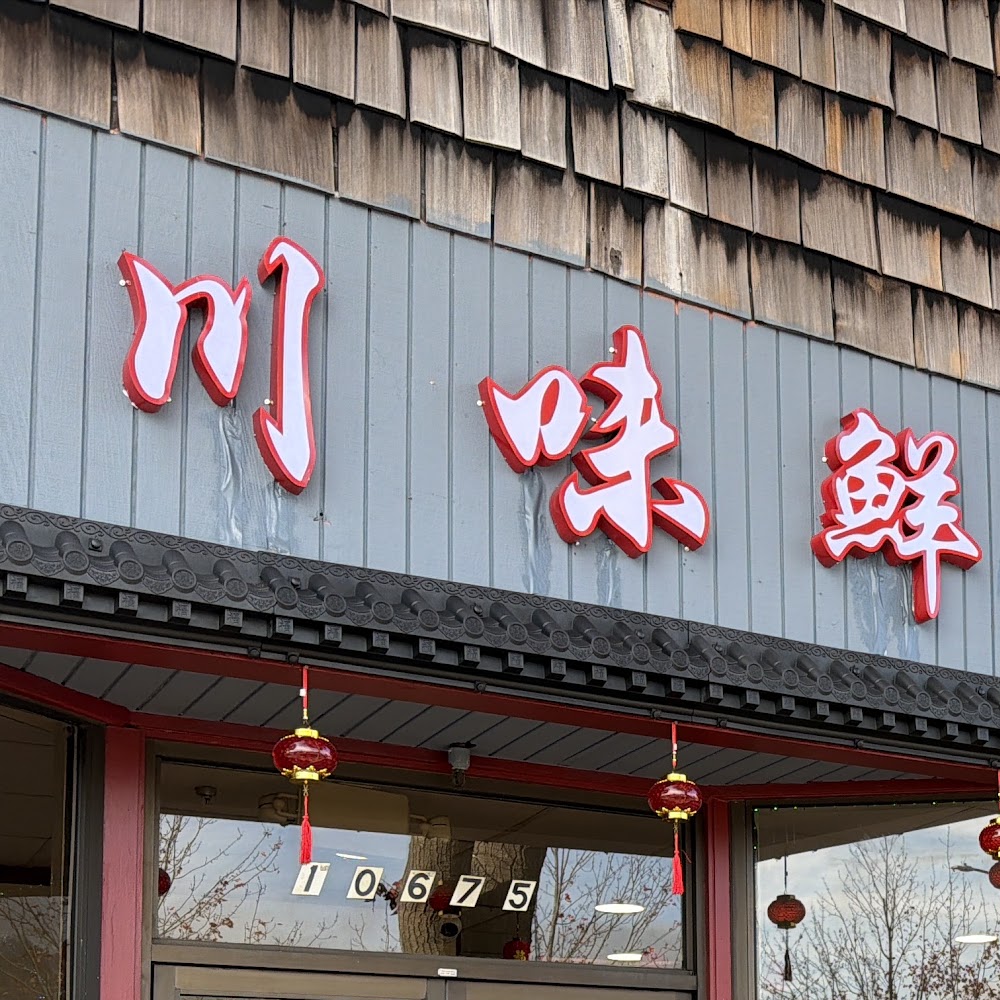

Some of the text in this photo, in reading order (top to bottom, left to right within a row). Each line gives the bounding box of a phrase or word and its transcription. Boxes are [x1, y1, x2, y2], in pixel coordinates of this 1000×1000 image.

[118, 235, 983, 623] 川味鲜
[300, 864, 535, 911] 10675
